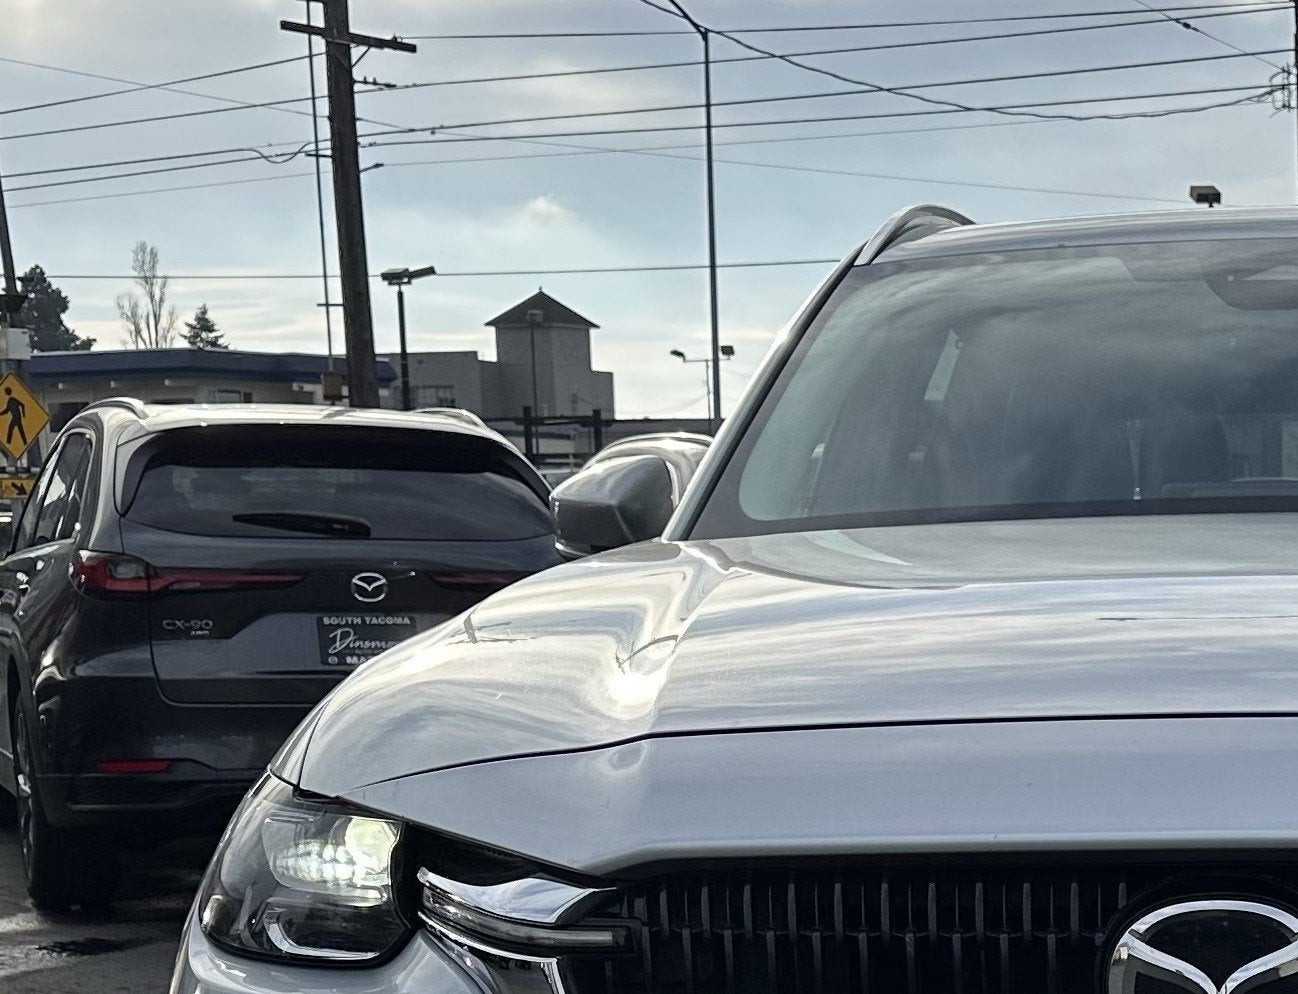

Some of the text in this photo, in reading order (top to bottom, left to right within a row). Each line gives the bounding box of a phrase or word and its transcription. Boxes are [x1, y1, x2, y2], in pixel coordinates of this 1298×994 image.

[162, 619, 213, 630] CX-90
[323, 616, 411, 625] SOUTH TACOMA
